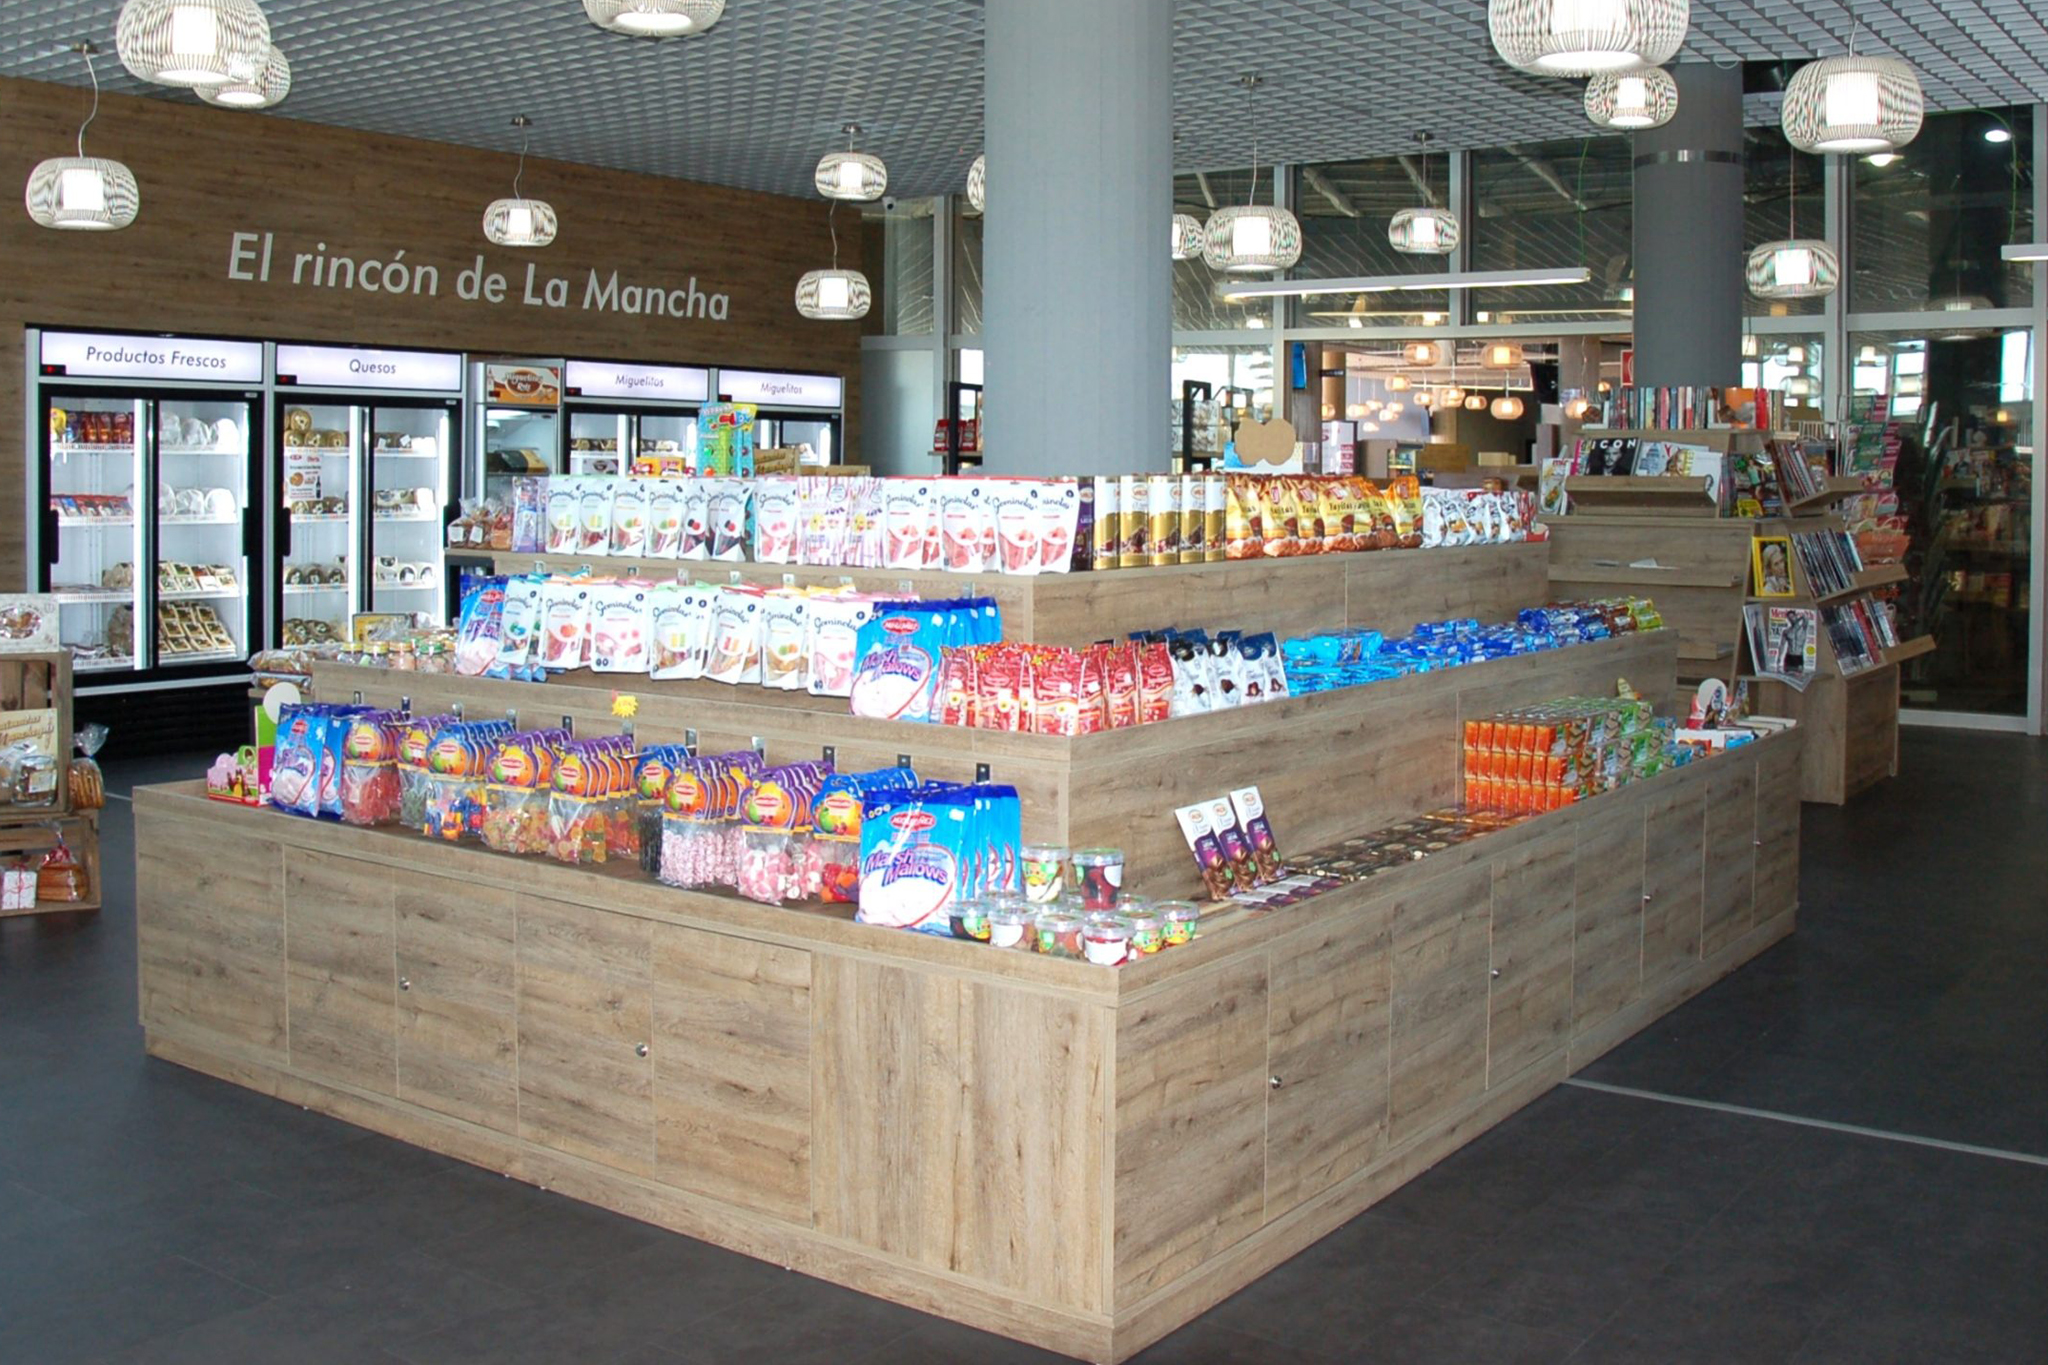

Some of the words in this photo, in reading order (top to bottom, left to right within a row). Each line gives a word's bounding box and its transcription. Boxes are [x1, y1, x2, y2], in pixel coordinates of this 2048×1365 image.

[228, 231, 274, 282] El
[292, 242, 439, 296] rincón
[456, 254, 507, 303] de
[523, 262, 569, 308] La
[582, 267, 729, 320] Mancha
[86, 346, 165, 365] Productos
[171, 350, 227, 369] Frescos
[349, 359, 397, 375] Quesos
[615, 374, 664, 389] Miguelitos
[760, 382, 803, 395] Miguelitos
[1591, 438, 1637, 449] ICON
[865, 848, 915, 875] Marsh
[881, 861, 948, 887] Mallows
